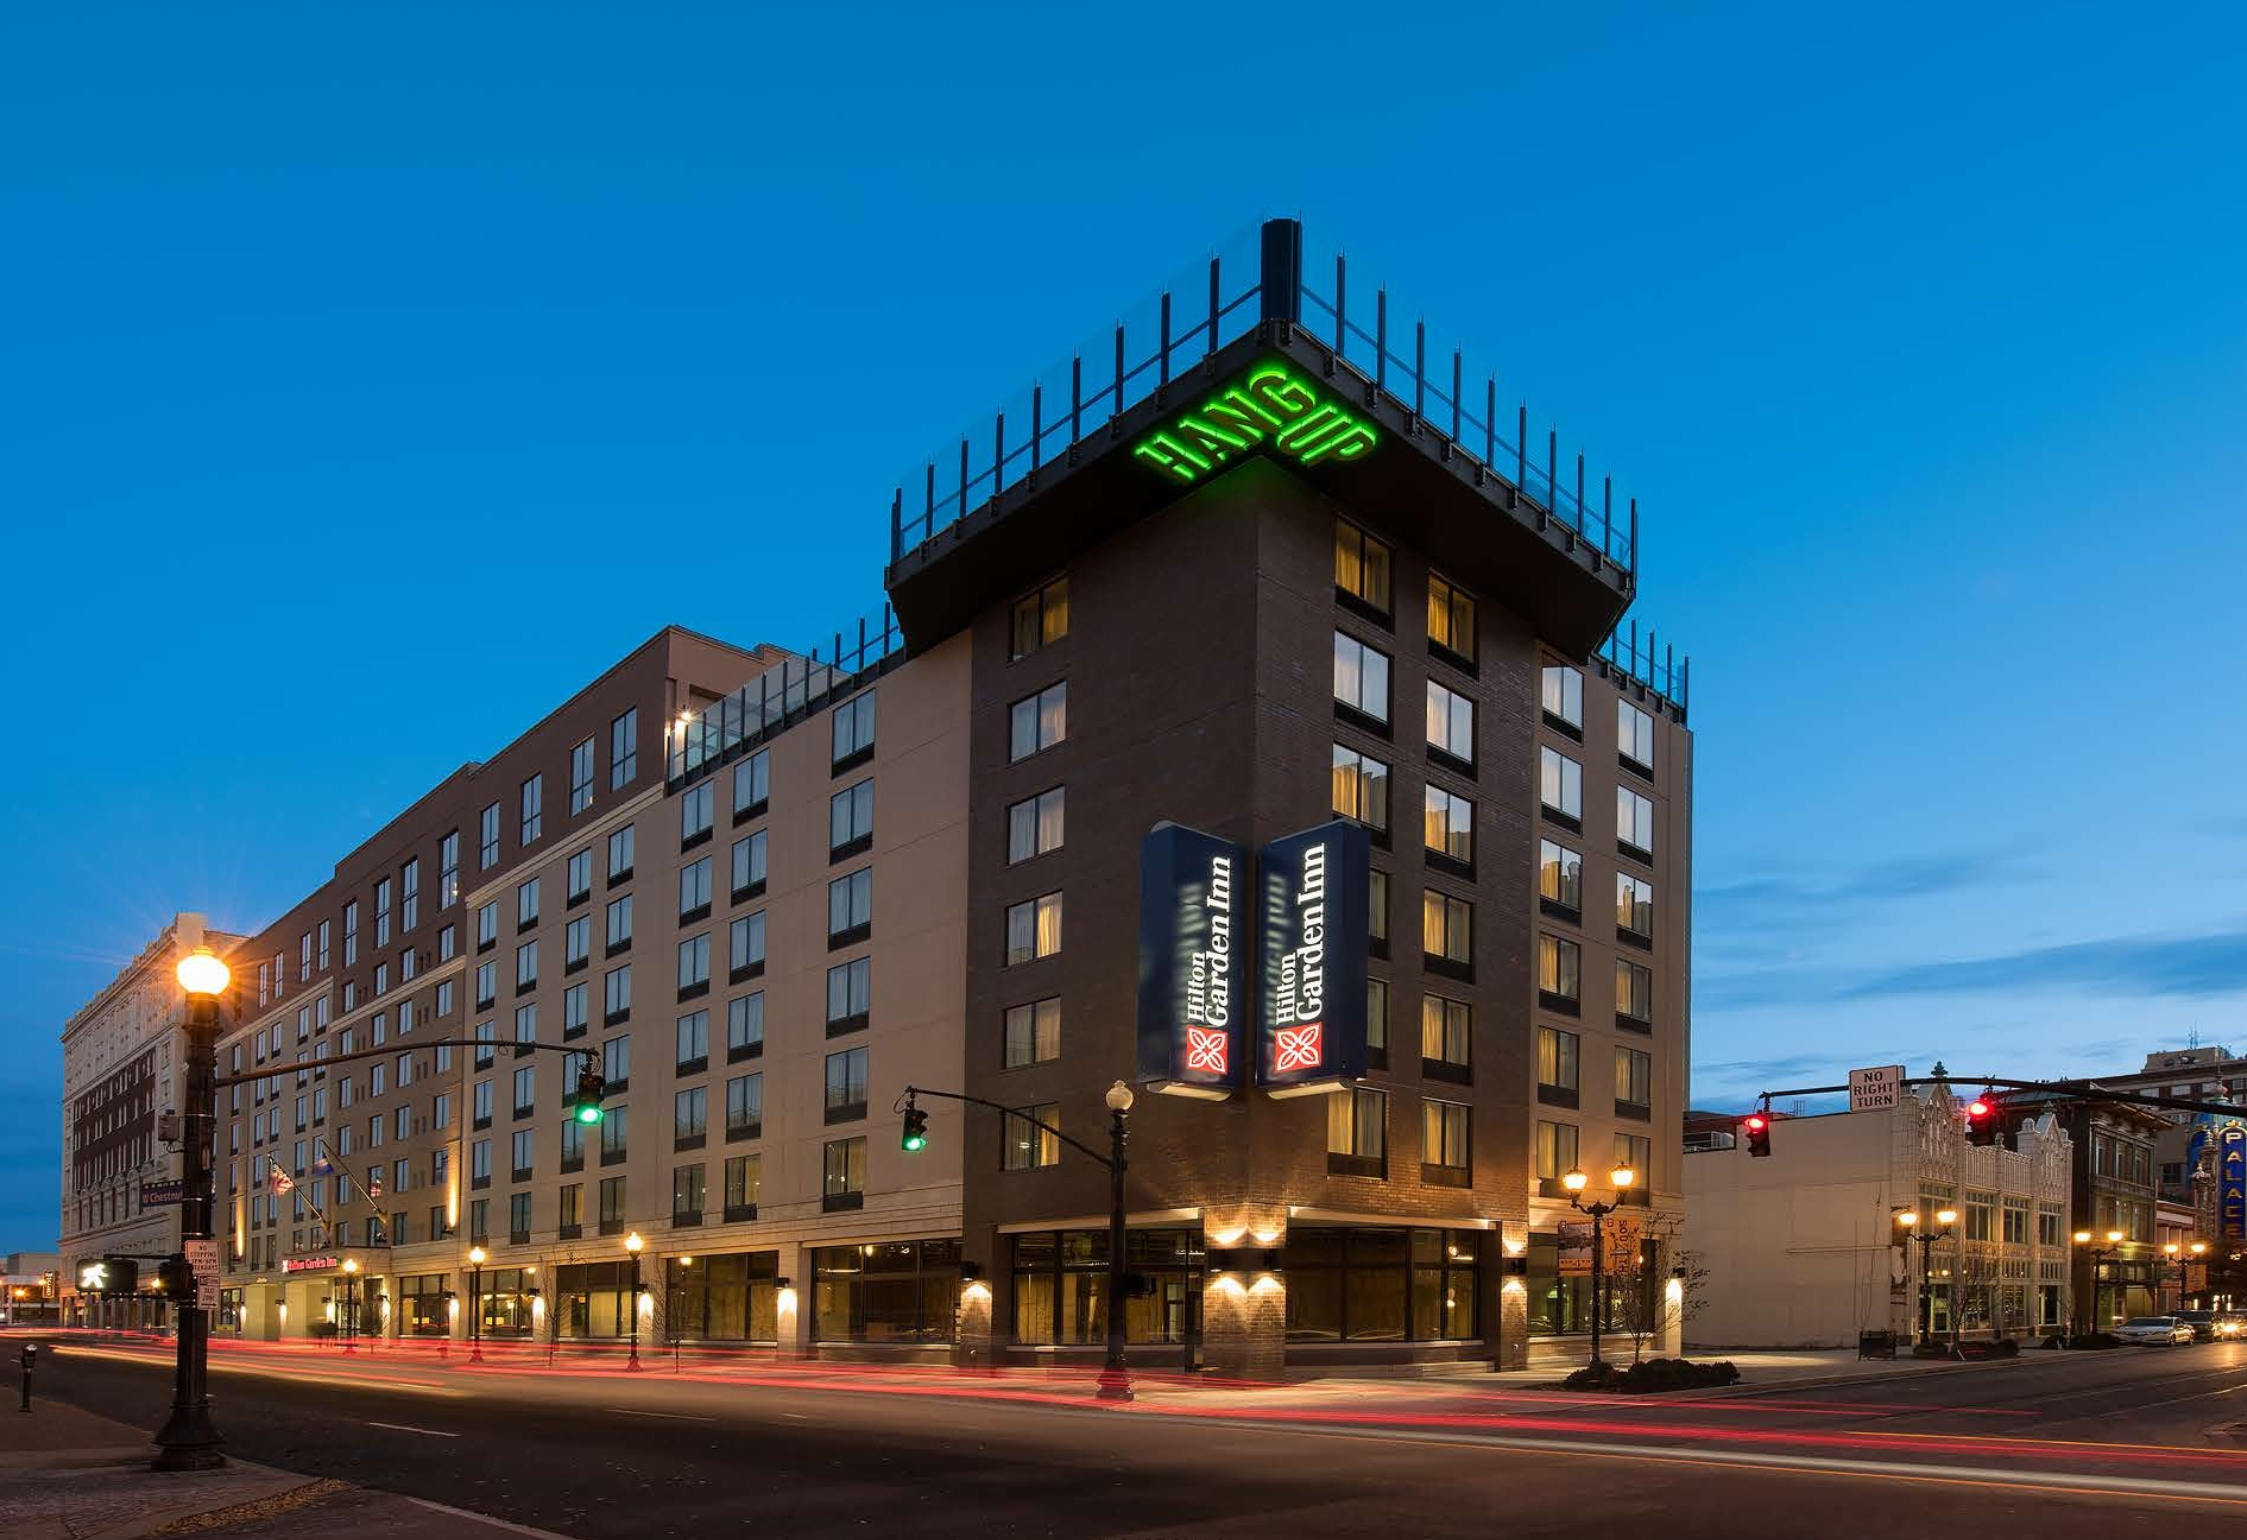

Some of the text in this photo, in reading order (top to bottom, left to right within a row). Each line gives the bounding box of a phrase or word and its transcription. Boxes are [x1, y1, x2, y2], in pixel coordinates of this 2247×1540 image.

[1135, 370, 1377, 483] HANG UP
[1205, 855, 1231, 1027] Garden Inn
[1295, 843, 1325, 1021] Garden Inn
[1187, 952, 1206, 1022] Hilton
[1276, 952, 1296, 1026] Hilton
[1854, 1082, 1894, 1095] RIGHT
[1857, 1095, 1892, 1107] TURN
[1864, 1071, 1883, 1082] NO
[2226, 1132, 2242, 1236] PALACE
[305, 1257, 326, 1269] Garden
[326, 1256, 337, 1267] Inn
